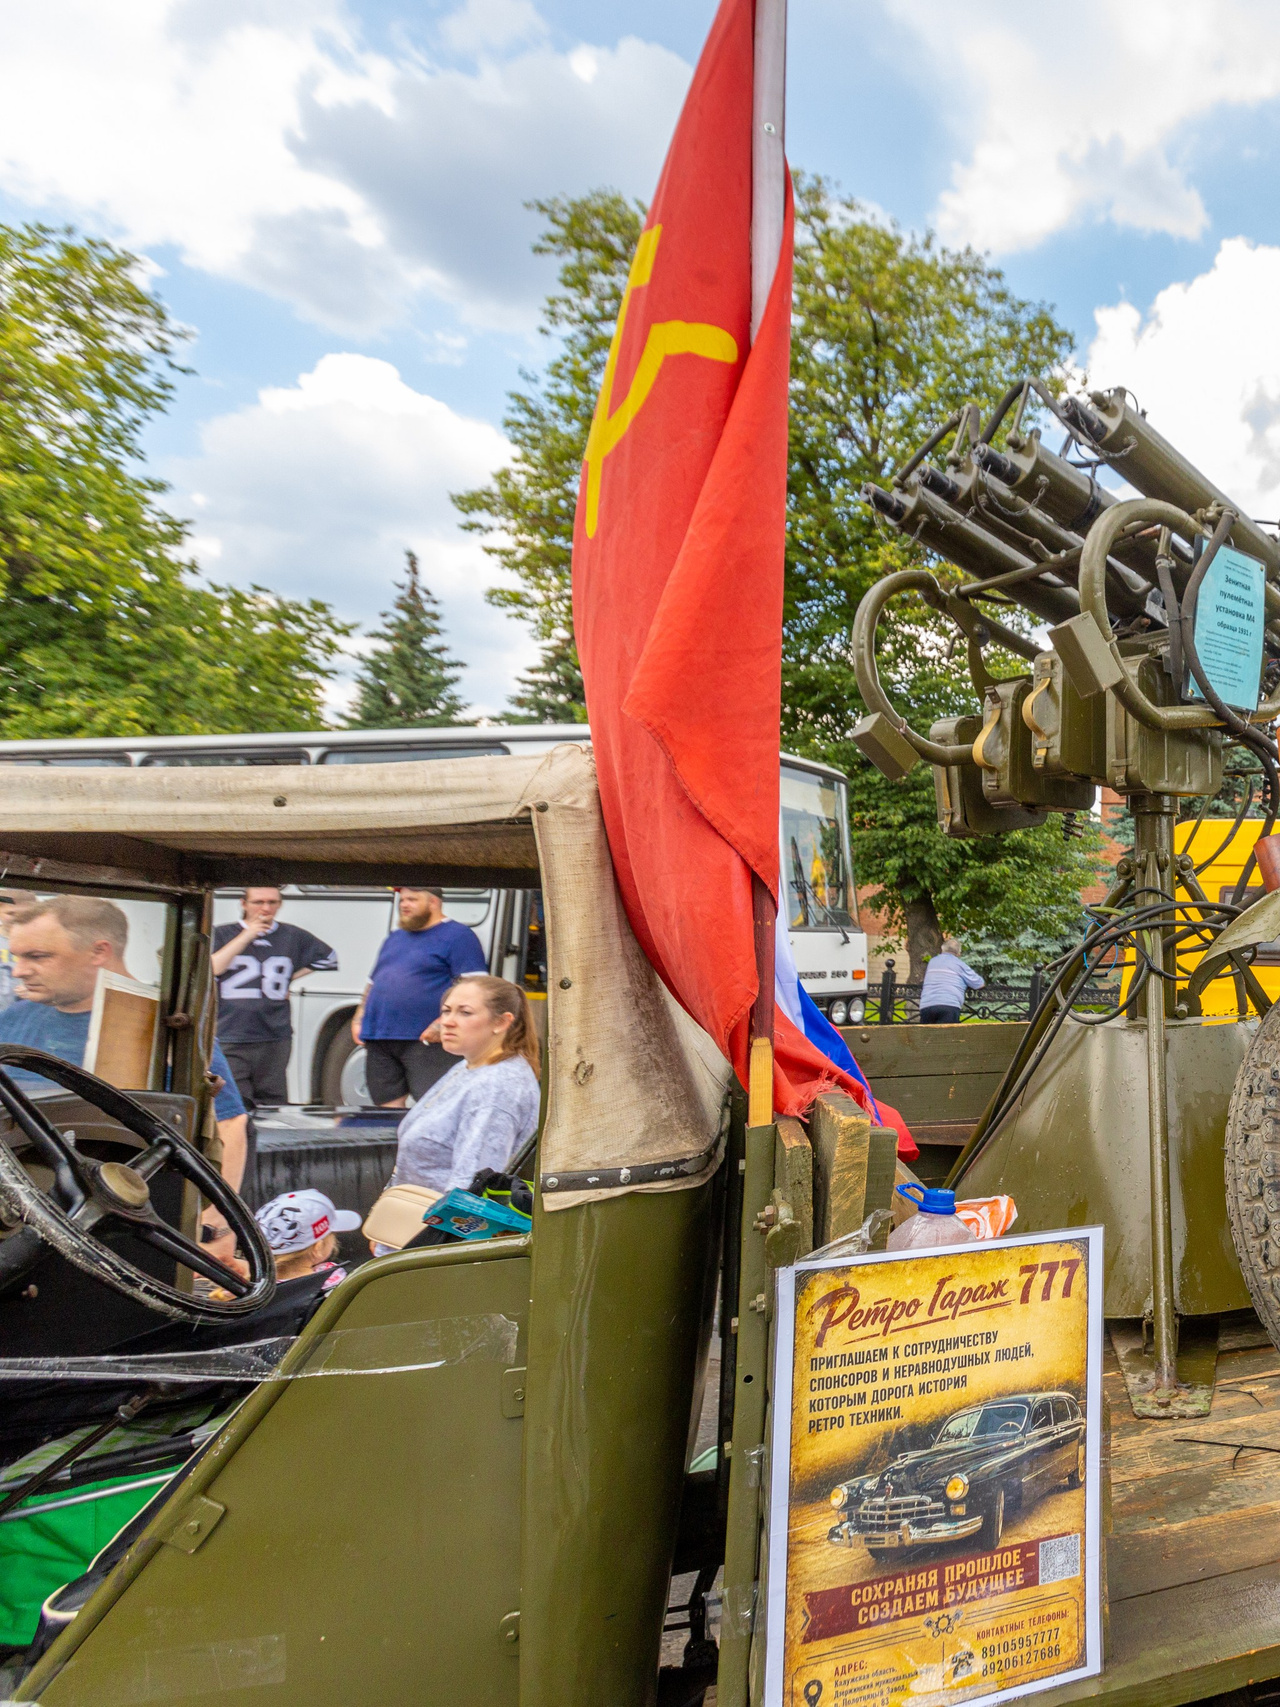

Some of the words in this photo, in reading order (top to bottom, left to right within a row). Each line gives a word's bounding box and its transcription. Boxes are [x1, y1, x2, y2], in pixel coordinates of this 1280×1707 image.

[1225, 575, 1250, 591] Зенитная
[1216, 605, 1245, 619] установка
[1220, 590, 1253, 607] пулемётная
[1217, 621, 1237, 632] образца
[221, 955, 294, 1000] 28
[807, 1281, 924, 1347] Ретро
[927, 1275, 1009, 1320] Гараж
[1018, 1258, 1080, 1304] 777
[810, 1348, 888, 1371] ПРИГЛАШАЕМ
[893, 1345, 899, 1359] К
[904, 1330, 998, 1357] СОТРУДНИЧЕСТВУ
[810, 1370, 877, 1392] СПОНСОРОВ
[882, 1367, 889, 1382] И
[894, 1351, 990, 1379] НЕРАВНОДУШНЫХ
[995, 1342, 1034, 1362] ЛЮДЕЙ,
[809, 1392, 866, 1413] КОТОРЫМ
[871, 1384, 914, 1405] ДОРОГА
[919, 1375, 967, 1395] ИСТОРИЯ
[808, 1415, 844, 1433] РЕТРО
[850, 1406, 903, 1426] ТЕХНИКИ.
[852, 1570, 938, 1606] СОХРАНЯЯ
[944, 1549, 1021, 1584] ПРОШЛОЕ
[858, 1590, 938, 1624] СОЗДАЕМ
[944, 1568, 1024, 1604] БУДУЩЕЕ
[977, 1620, 1024, 1640] КОНТАКТНЫЕ
[1028, 1610, 1069, 1627] ТЕЛЕФОНЫ:
[982, 1628, 1059, 1659] 89105957777
[834, 1660, 868, 1677] АДРЕС:
[982, 1644, 1060, 1677] 89206127686
[834, 1673, 870, 1688] Калужская
[834, 1682, 873, 1700] Дзержинский
[842, 1690, 884, 1706] Полотняный
